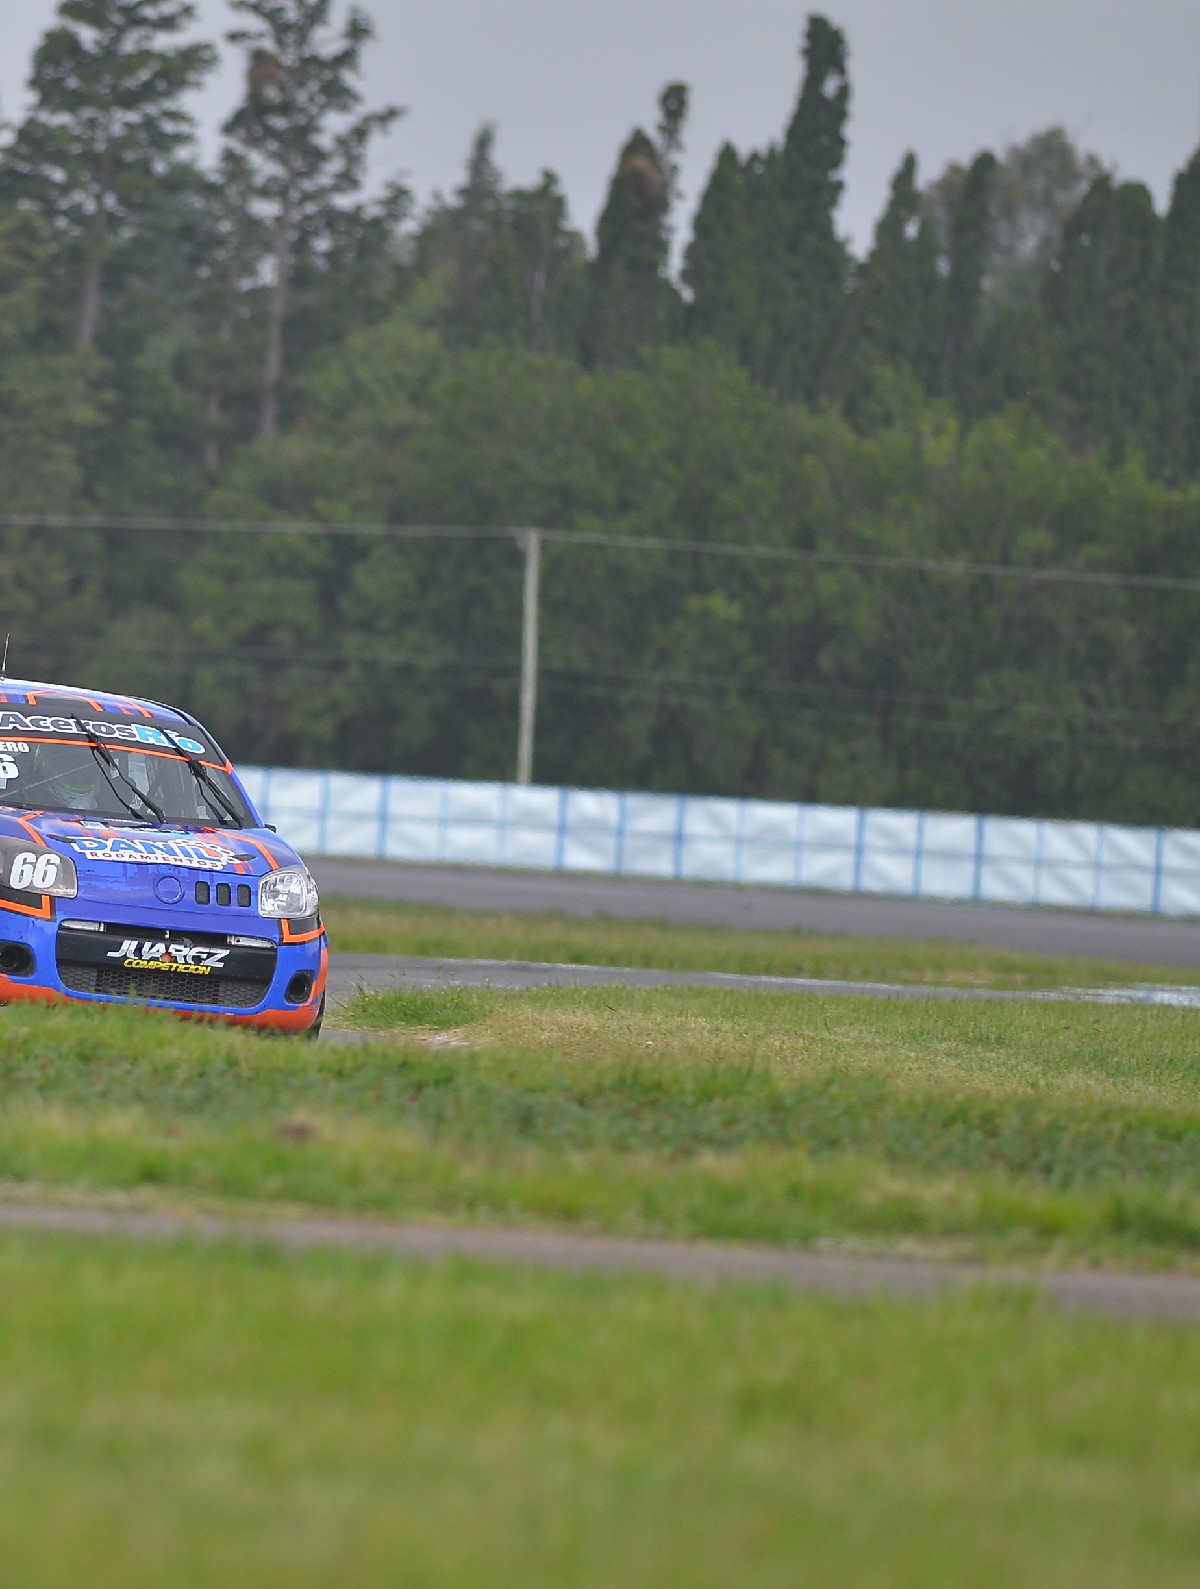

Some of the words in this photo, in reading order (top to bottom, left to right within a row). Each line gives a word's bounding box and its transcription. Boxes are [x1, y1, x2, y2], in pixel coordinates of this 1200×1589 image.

[89, 851, 219, 868] RODAMIENTOS
[9, 852, 59, 890] 66
[107, 939, 231, 967] JUAREZ
[123, 958, 212, 975] COMPETICION
